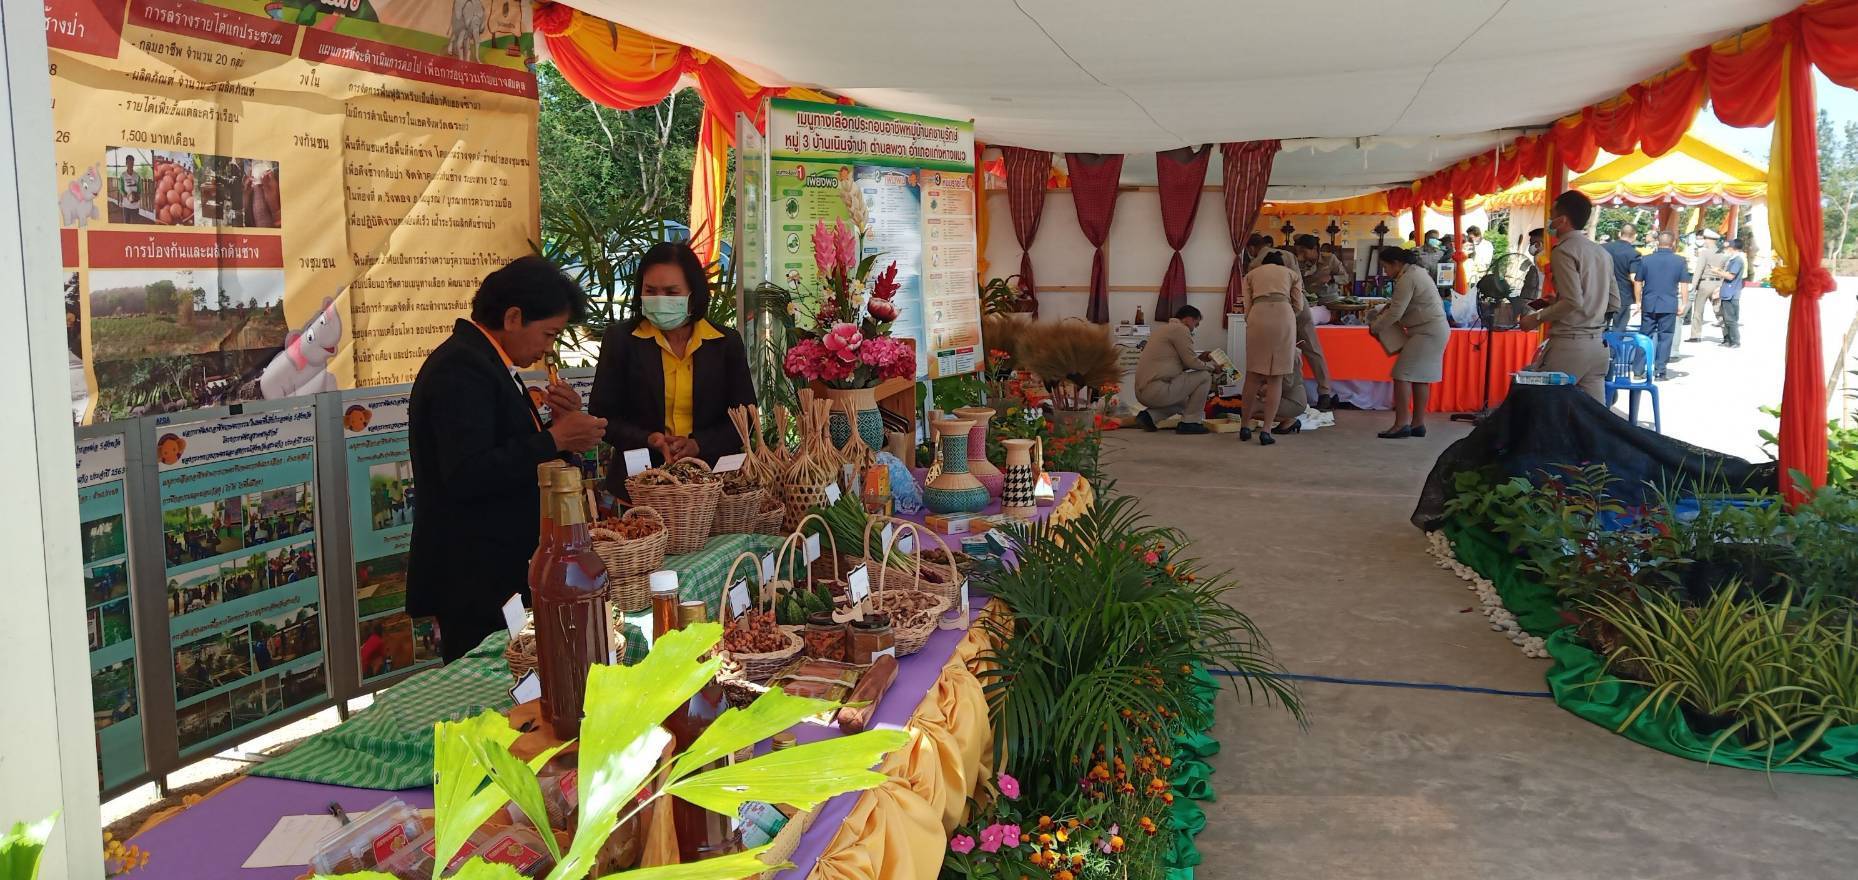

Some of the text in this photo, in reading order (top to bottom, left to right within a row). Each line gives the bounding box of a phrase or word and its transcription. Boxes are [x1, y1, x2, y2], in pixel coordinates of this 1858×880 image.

[187, 48, 213, 63] จำนวน
[216, 54, 228, 65] 20
[300, 68, 320, 87] วงใน
[56, 131, 70, 143] 26
[121, 129, 195, 147] 1,500 บาท/เดือน
[293, 134, 330, 151] วงกันชน
[785, 131, 799, 153] หมู่
[802, 134, 809, 148] 3
[870, 138, 906, 156] ตำบลพวา
[490, 177, 497, 185] 12
[125, 236, 259, 259] การป้องกันและผลักดันช้าง
[299, 257, 336, 272] วงชุมชน
